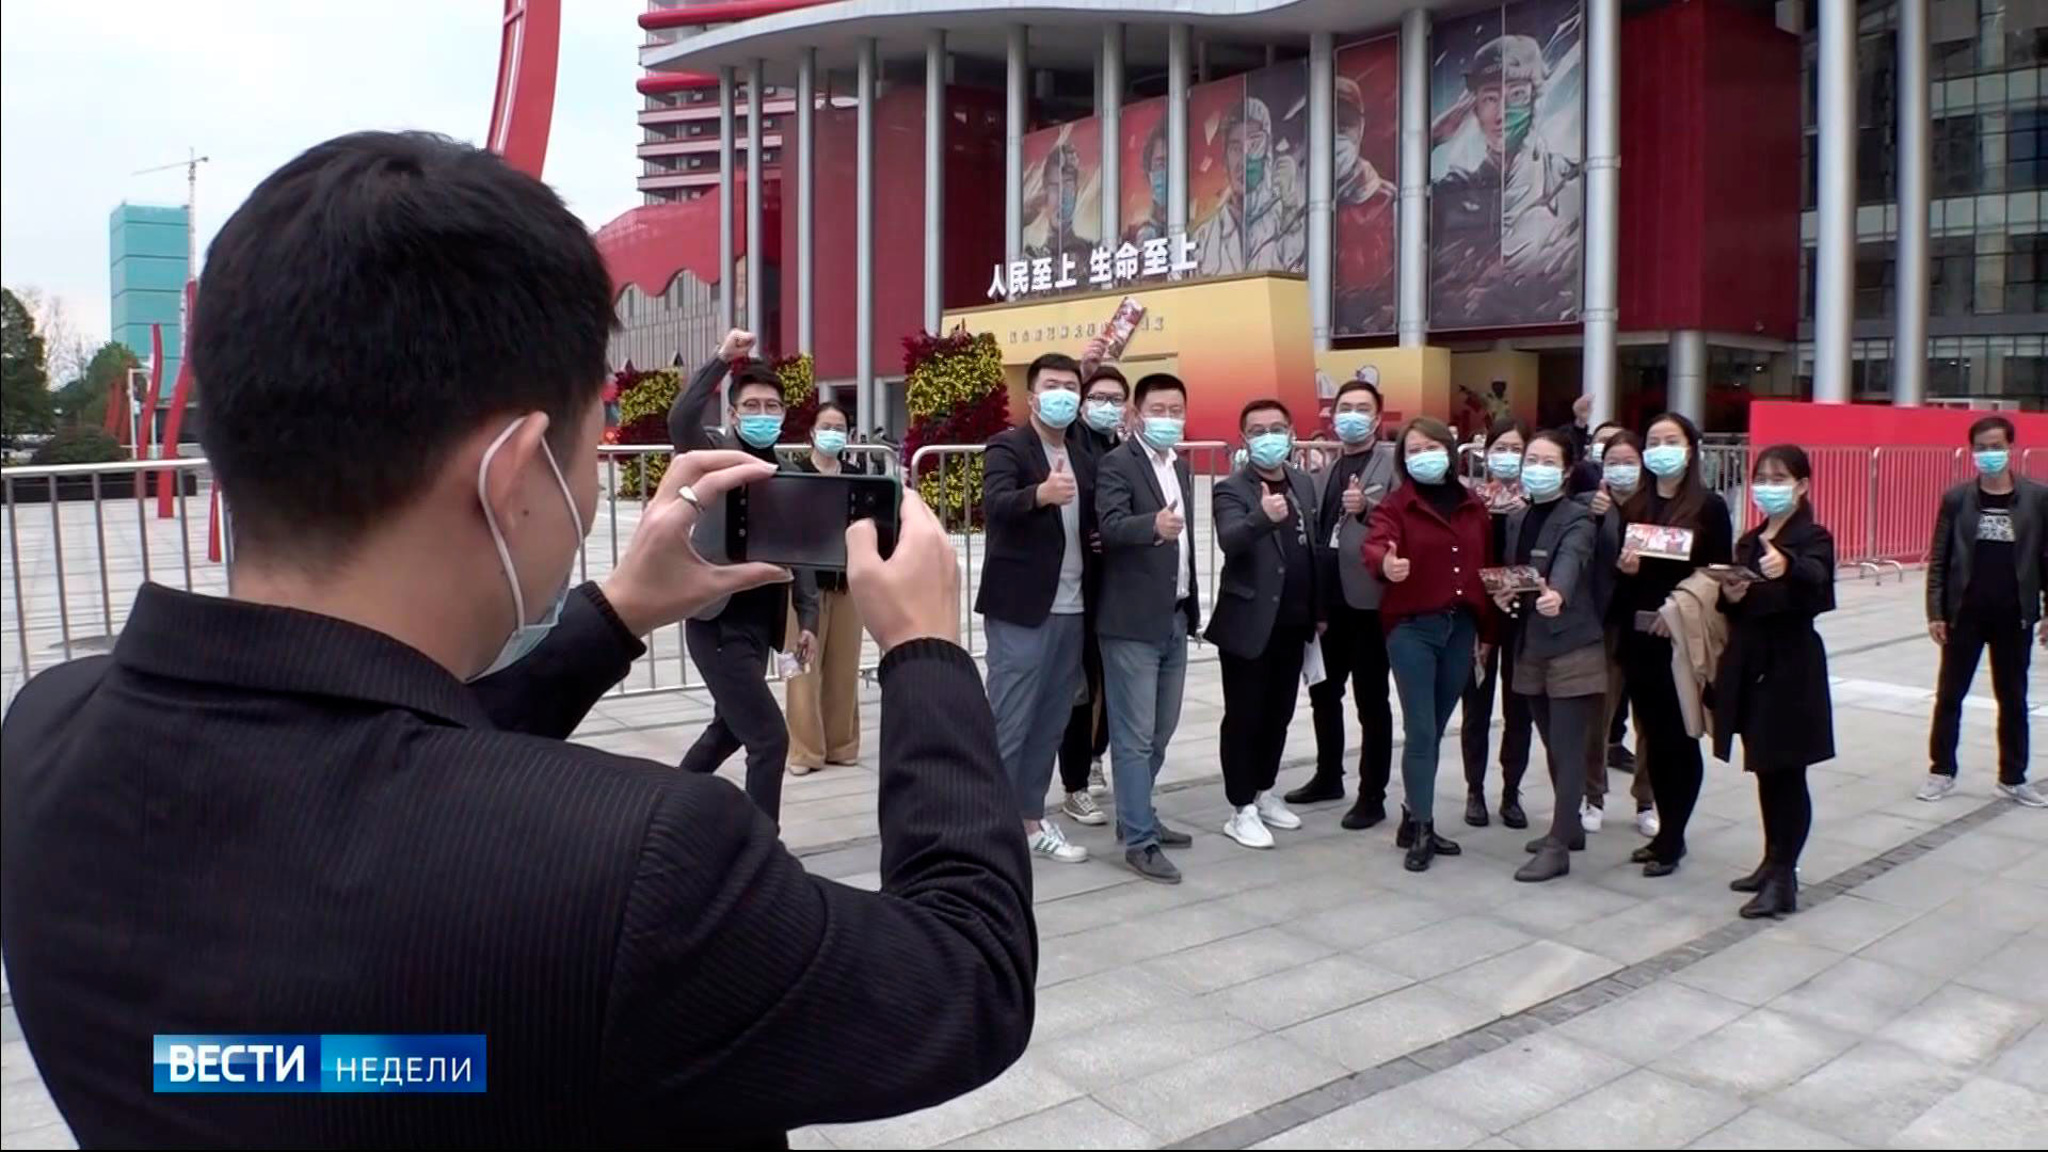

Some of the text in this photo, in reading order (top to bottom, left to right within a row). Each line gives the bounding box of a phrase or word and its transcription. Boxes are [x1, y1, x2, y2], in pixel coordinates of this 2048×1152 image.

[987, 232, 1199, 298] 人民至上 生命至上
